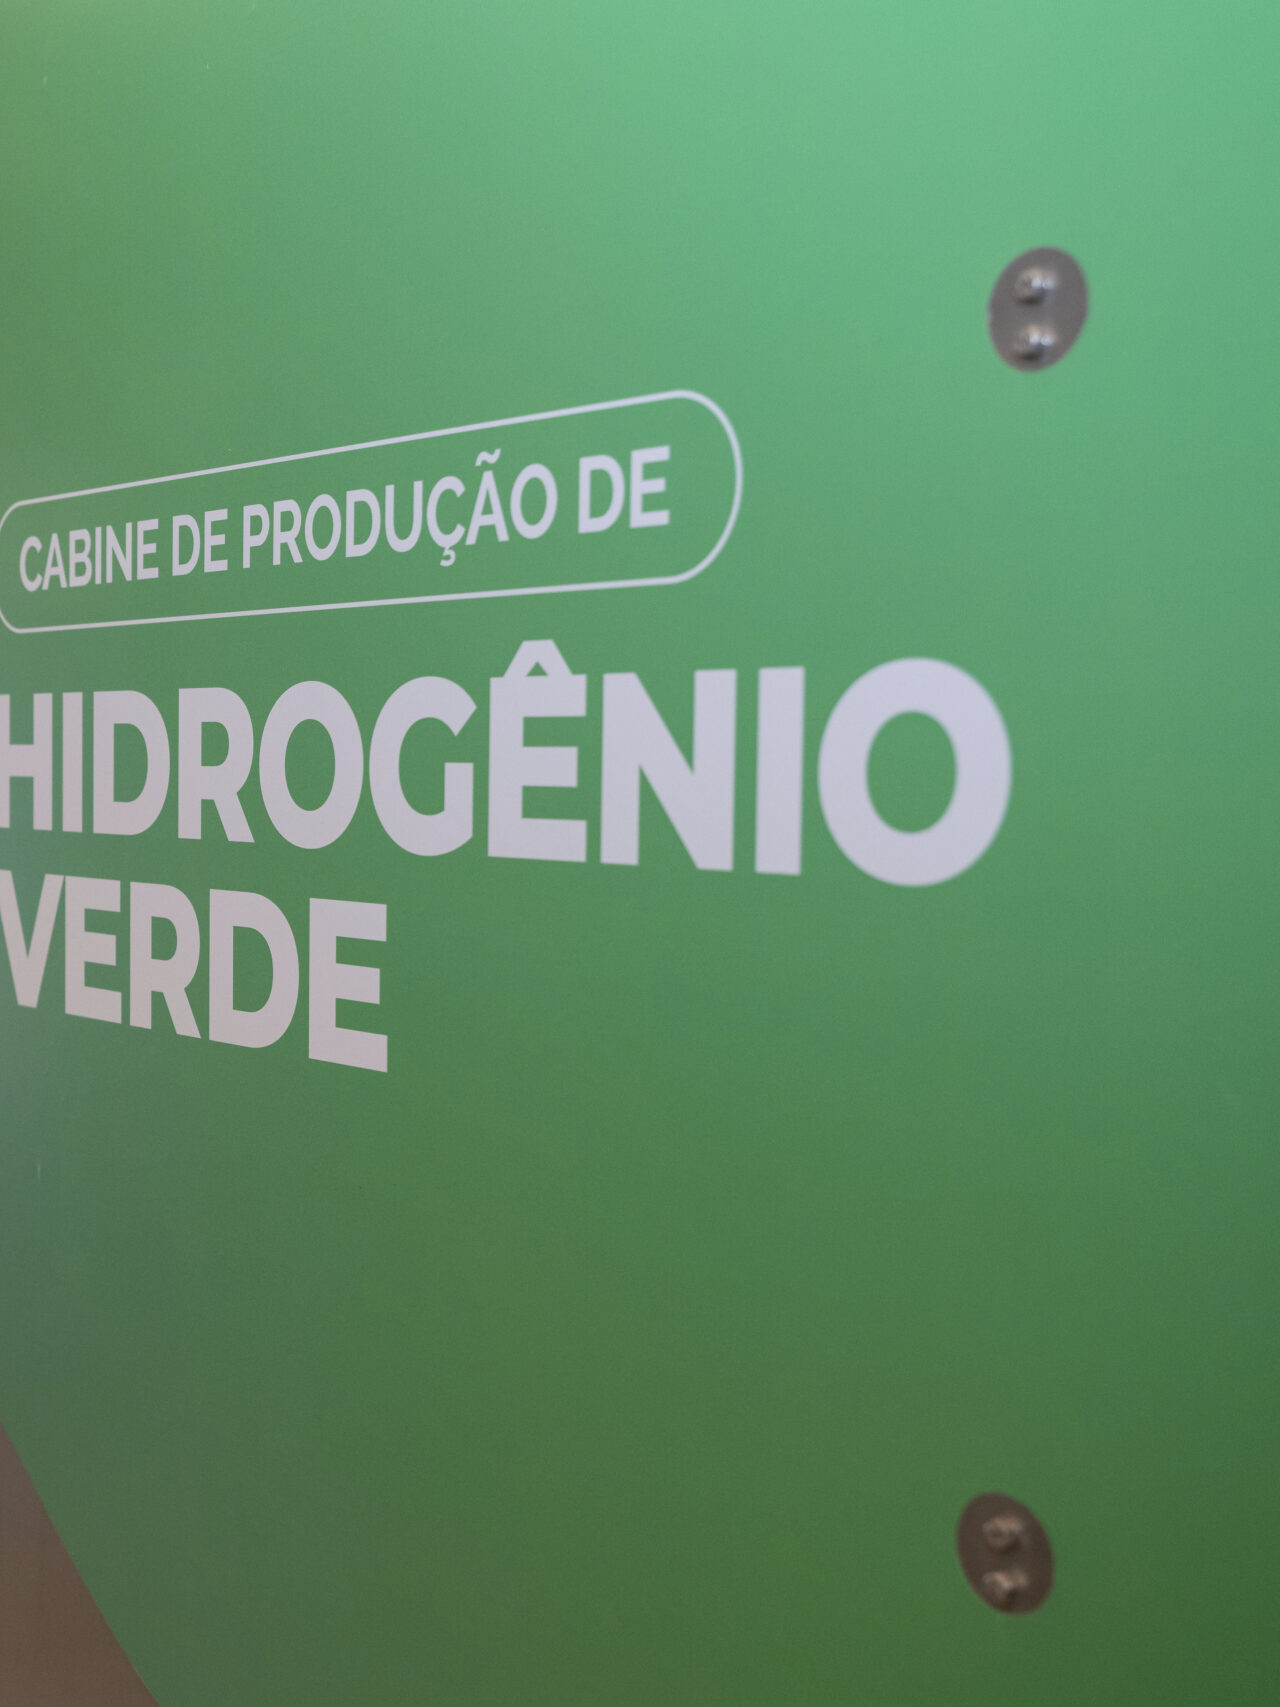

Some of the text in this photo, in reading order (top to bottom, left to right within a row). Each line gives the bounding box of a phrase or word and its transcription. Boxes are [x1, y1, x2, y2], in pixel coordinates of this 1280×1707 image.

[19, 445, 672, 593] CABINE DE PRODUÇÃO DE
